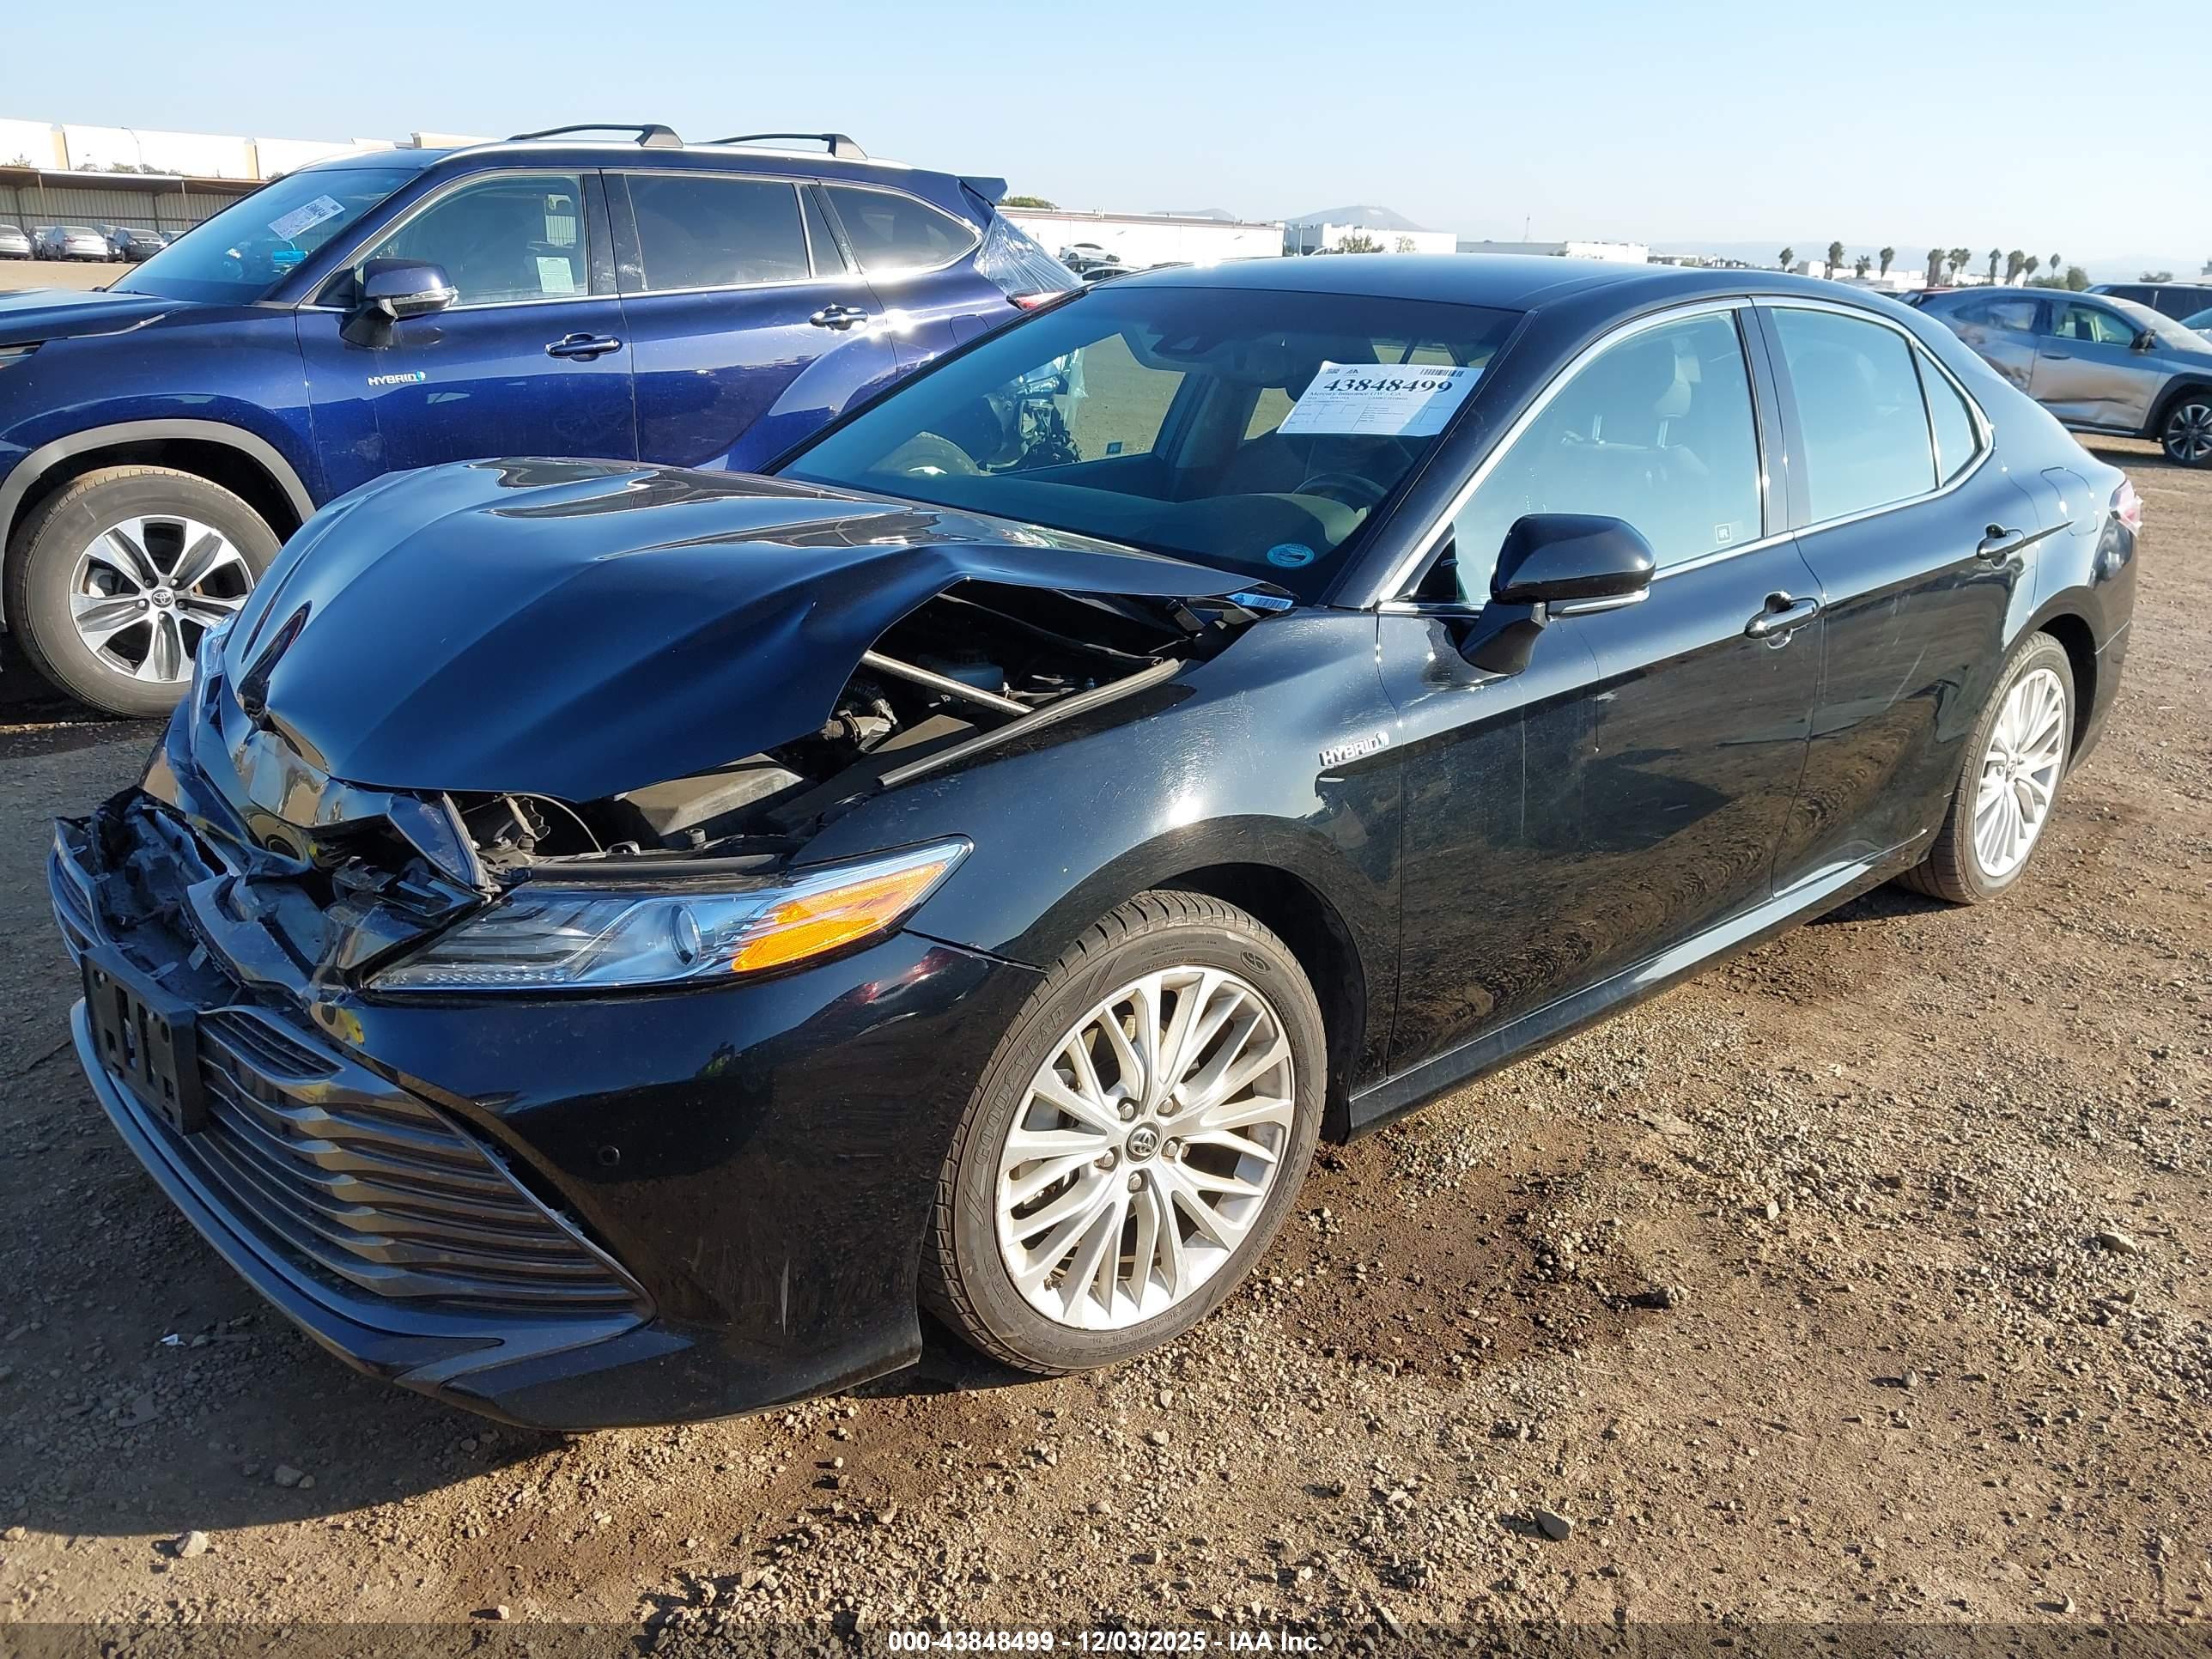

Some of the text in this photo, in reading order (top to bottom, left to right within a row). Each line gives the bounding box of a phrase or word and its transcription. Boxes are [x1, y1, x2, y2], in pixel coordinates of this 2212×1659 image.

[368, 374, 417, 386] HYBRID
[1323, 378, 1453, 393] 43848499
[1319, 738, 1380, 766] HYBRID
[974, 1005, 1066, 1166] GOODYEAR
